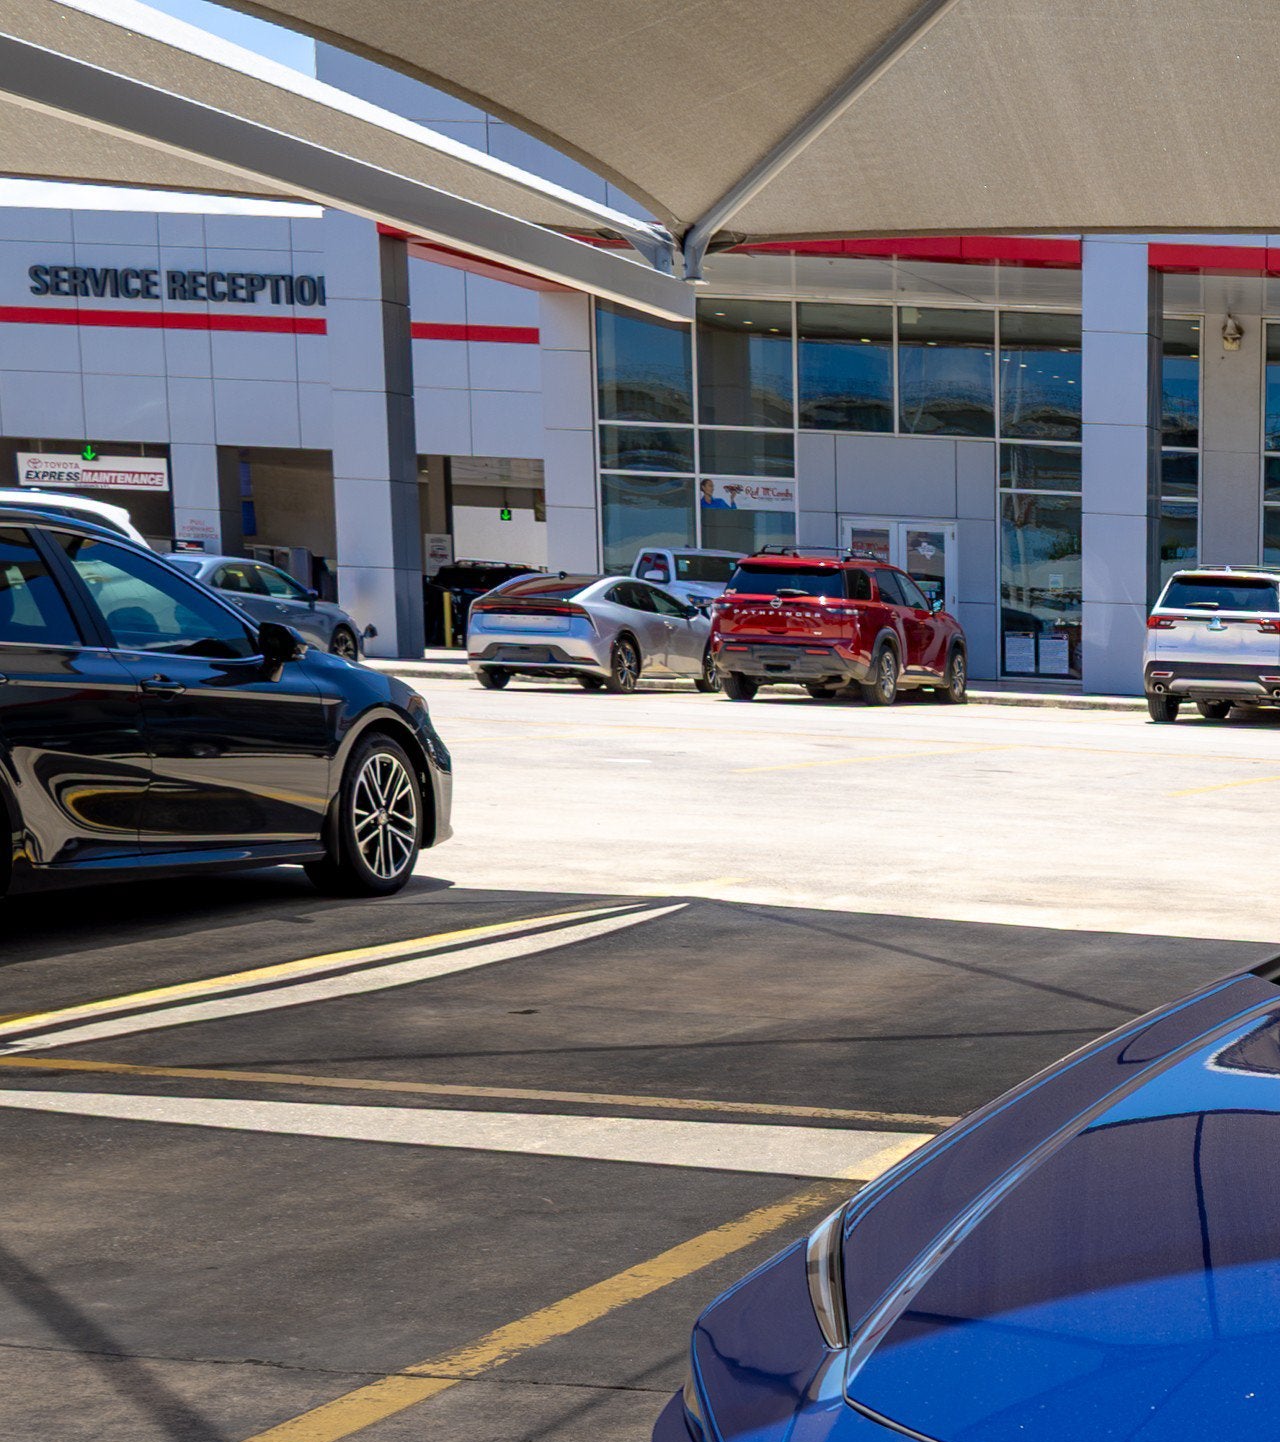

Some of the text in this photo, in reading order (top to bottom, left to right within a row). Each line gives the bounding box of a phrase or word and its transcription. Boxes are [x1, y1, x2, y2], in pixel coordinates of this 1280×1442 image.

[28, 265, 160, 300] SERVICE
[44, 461, 80, 470] TOYOTA
[25, 470, 80, 481] EXPRESS
[82, 472, 163, 485] MAINTENANCE
[733, 608, 822, 618] PATHFINDER
